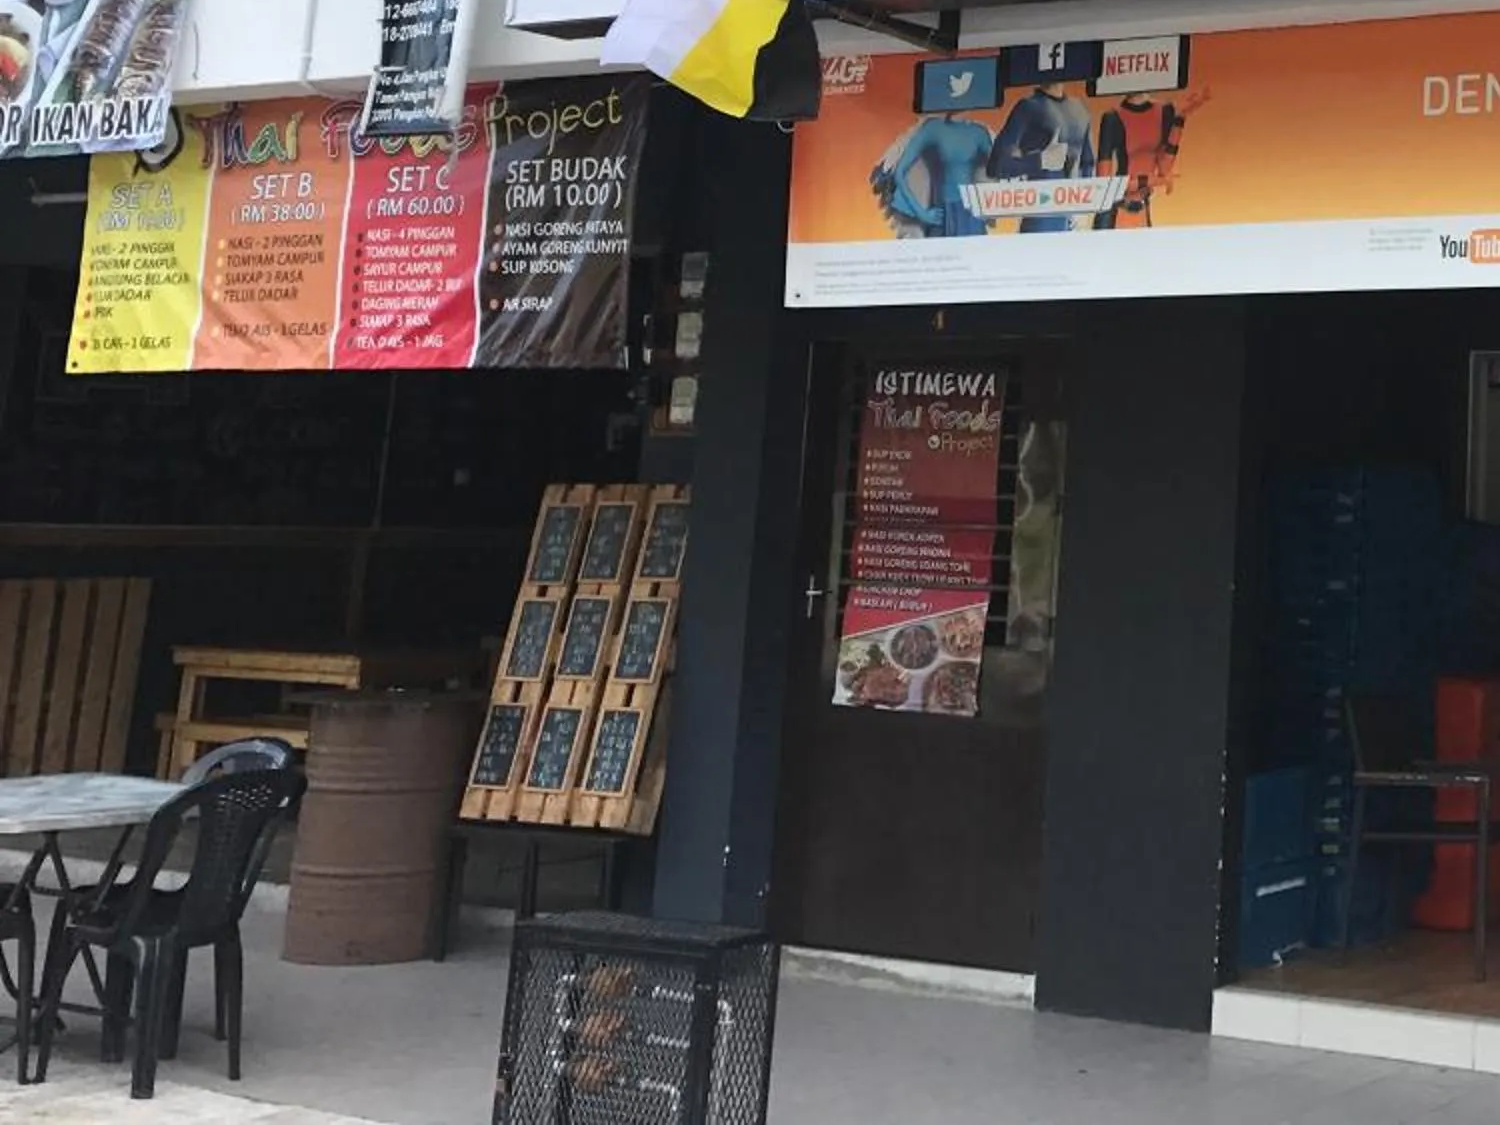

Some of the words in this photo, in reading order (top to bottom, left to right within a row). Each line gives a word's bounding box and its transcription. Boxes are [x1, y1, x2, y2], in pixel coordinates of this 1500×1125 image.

[1105, 49, 1171, 77] NETFLIX
[32, 102, 94, 146] IKAN
[483, 88, 624, 156] Project
[386, 166, 431, 193] SET
[435, 165, 451, 191] C
[505, 160, 545, 184] SET
[550, 155, 628, 182] BUDAK
[251, 174, 292, 200] SET
[297, 172, 314, 198] B
[982, 184, 1036, 209] VIDEO
[501, 241, 538, 256] AYAM
[874, 370, 996, 396] ISTIMEWA
